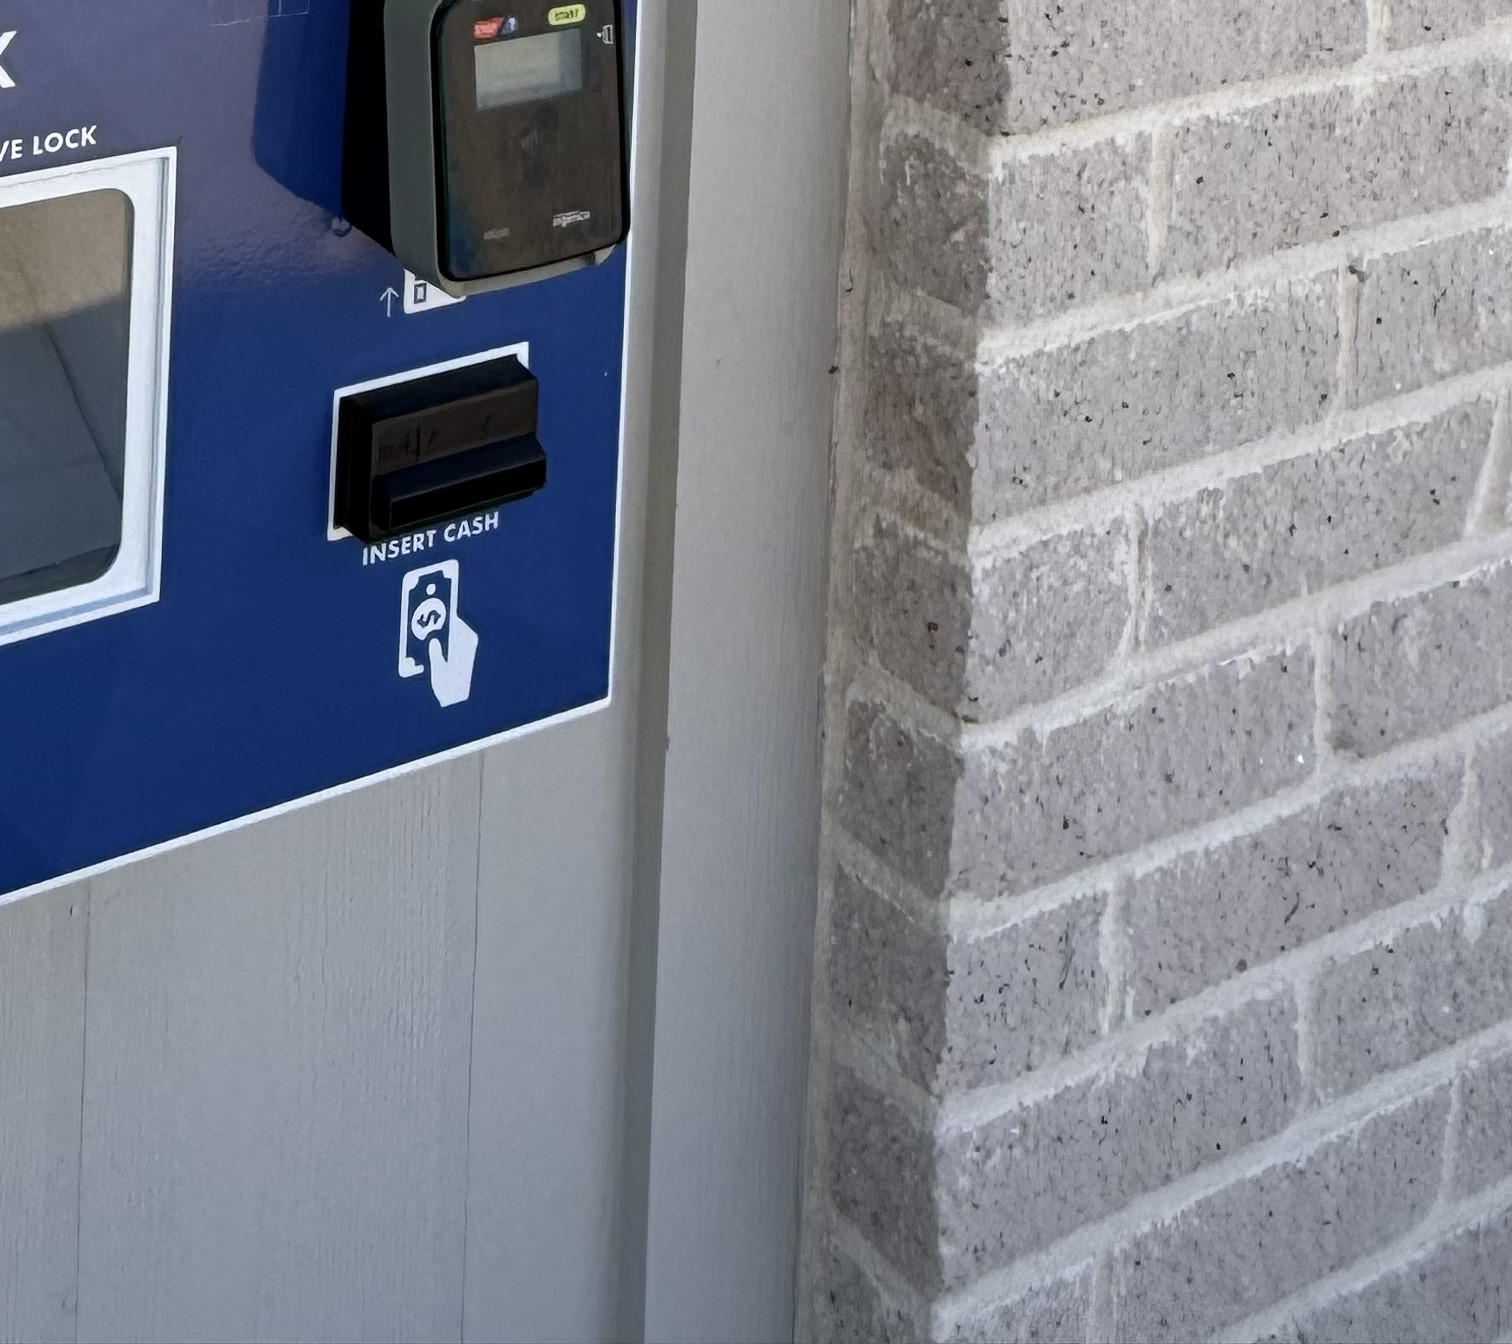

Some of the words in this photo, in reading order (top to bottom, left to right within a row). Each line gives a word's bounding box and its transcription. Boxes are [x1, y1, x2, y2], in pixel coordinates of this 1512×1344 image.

[32, 124, 98, 156] LOCK
[361, 529, 438, 567] INSERT
[443, 511, 500, 543] CASH
